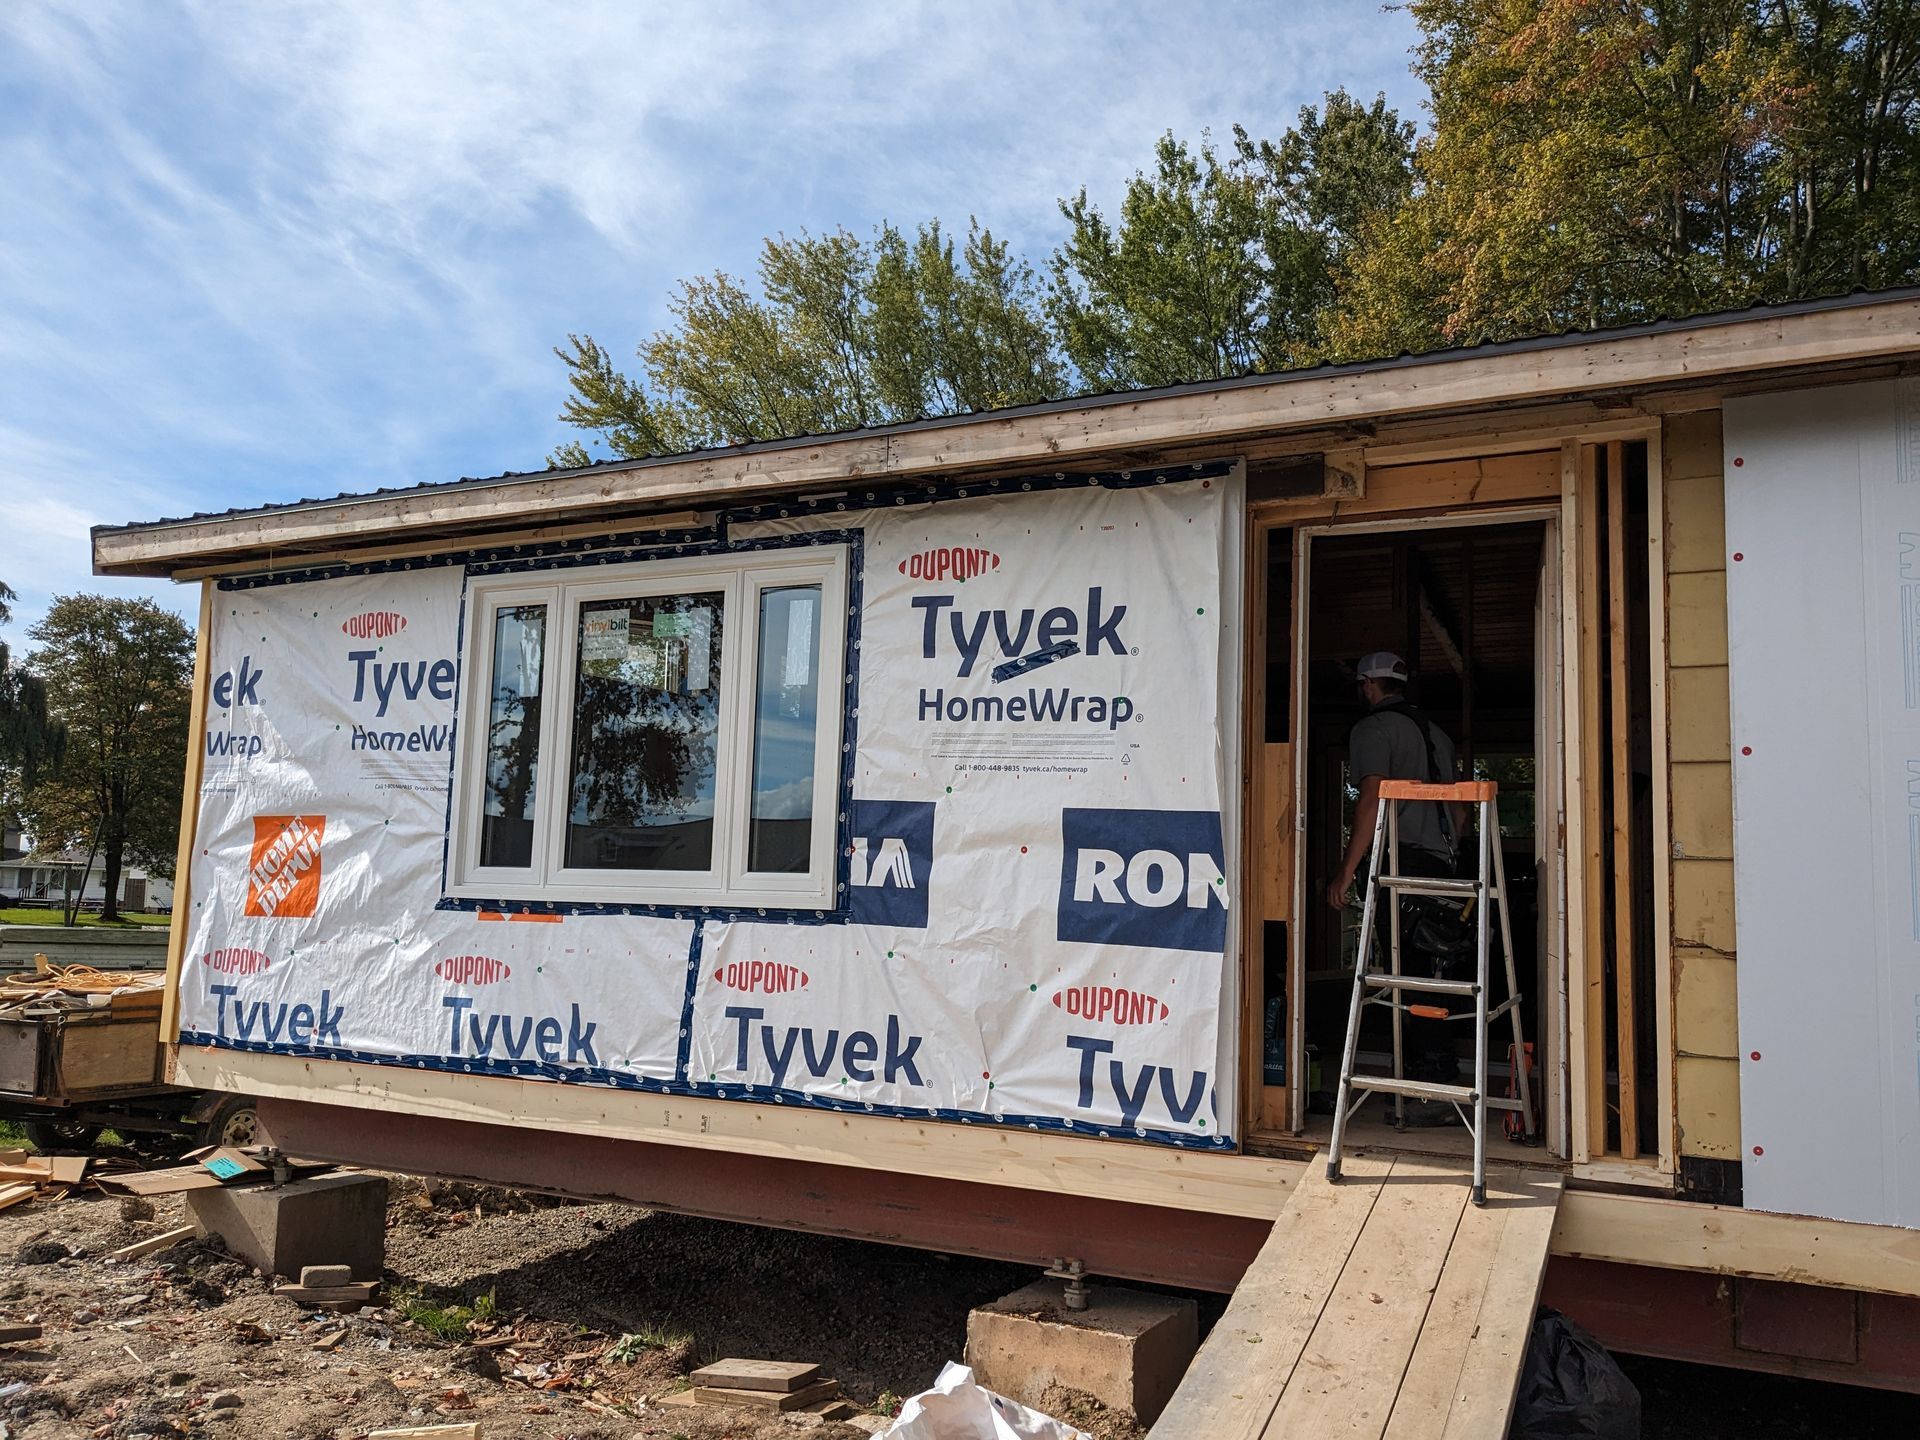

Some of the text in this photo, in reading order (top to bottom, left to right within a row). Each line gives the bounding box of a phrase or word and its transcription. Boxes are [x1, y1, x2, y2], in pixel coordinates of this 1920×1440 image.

[909, 547, 991, 581] DUPONT
[349, 611, 401, 639] DUPONT
[911, 586, 1128, 678] Tyvek
[209, 655, 263, 709] ek
[918, 687, 1135, 731] HomeWrap
[954, 763, 1088, 774] Call 1-800-448-9835 tyvek.ca/homewrap
[250, 816, 309, 895] HOME
[257, 829, 321, 917] DEPOT
[213, 947, 265, 976] DUPONT
[443, 955, 504, 986] DUPONT
[726, 960, 800, 994] DUPONT
[1066, 986, 1159, 1025] DUPONT
[725, 1006, 925, 1088] Tyvek
[1066, 1035, 1217, 1128] Tyv
[1263, 1063, 1285, 1071] akita
